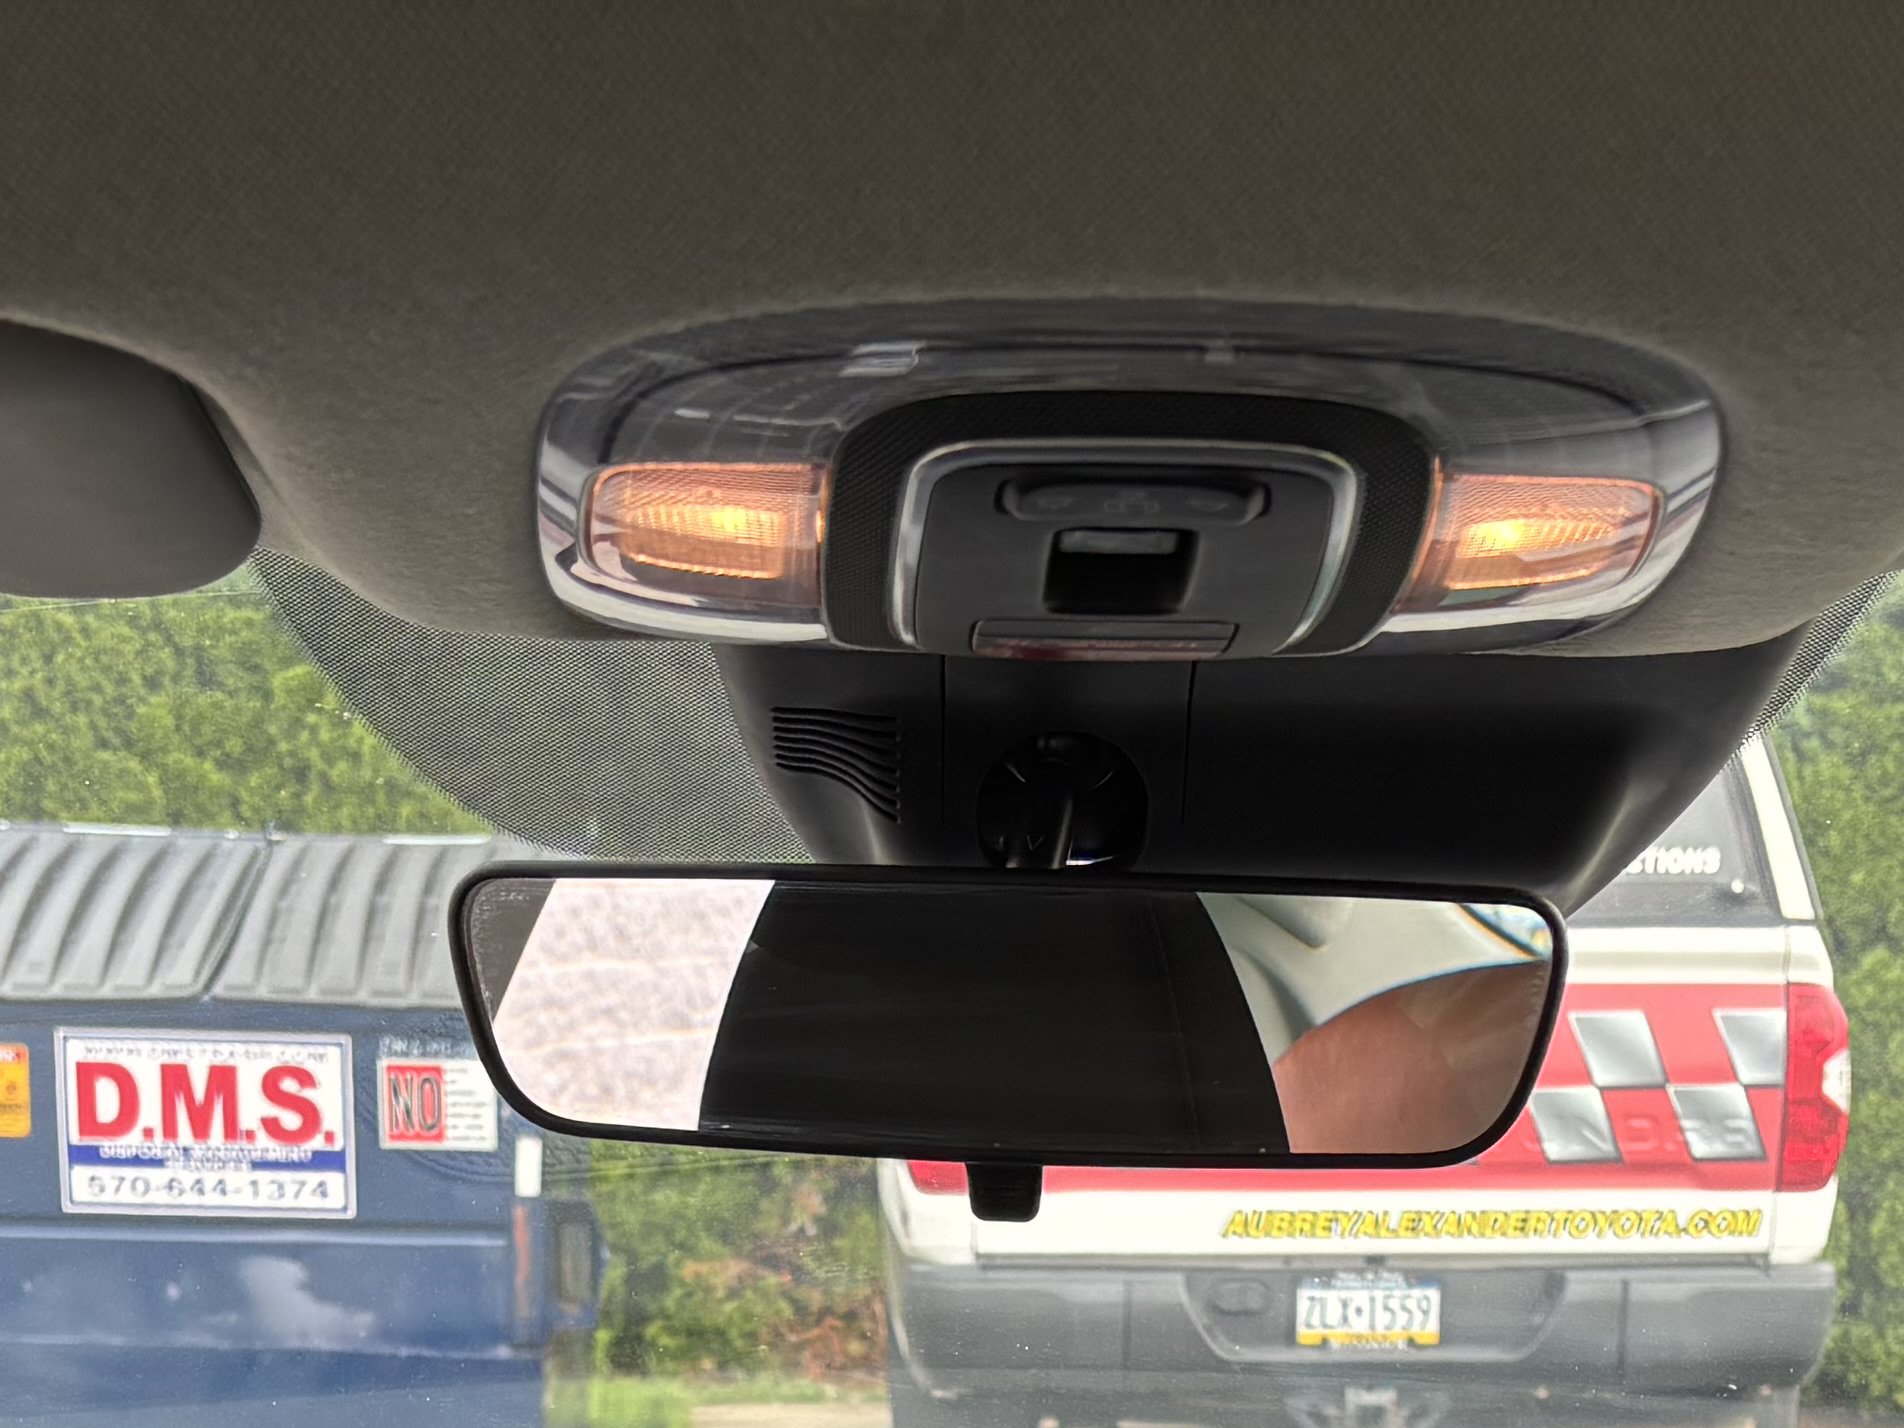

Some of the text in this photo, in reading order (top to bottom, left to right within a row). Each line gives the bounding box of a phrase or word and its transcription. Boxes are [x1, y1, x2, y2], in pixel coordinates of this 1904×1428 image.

[75, 1060, 335, 1146] D.M.S.
[388, 1072, 442, 1136] NO
[86, 1174, 330, 1201] 570-644-1374
[1221, 1209, 1763, 1240] AUBREYALEXANDERTOYOTA.COM
